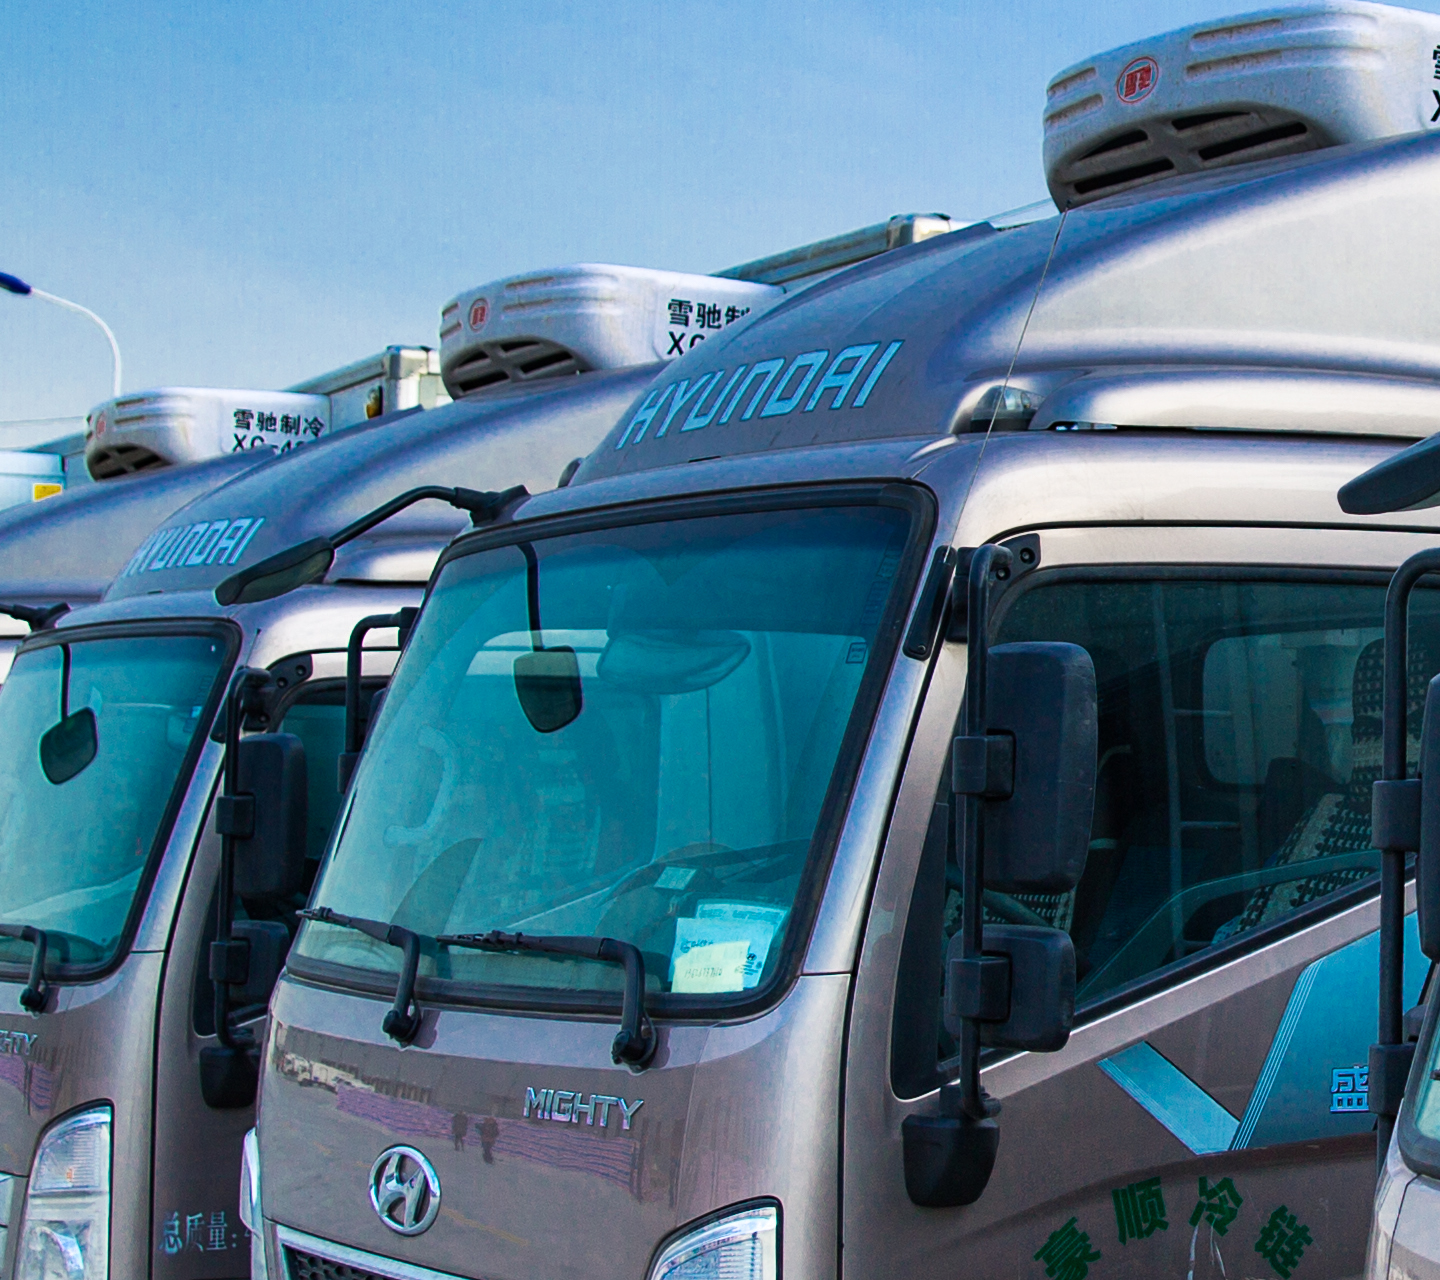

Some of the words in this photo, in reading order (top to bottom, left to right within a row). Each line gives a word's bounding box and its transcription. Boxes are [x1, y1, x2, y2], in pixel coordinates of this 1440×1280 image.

[615, 339, 906, 452] HYUNDAI
[233, 408, 325, 438] 雪驰制冷
[121, 517, 266, 578] HYUNDAI
[523, 1086, 644, 1130] MIGHTY
